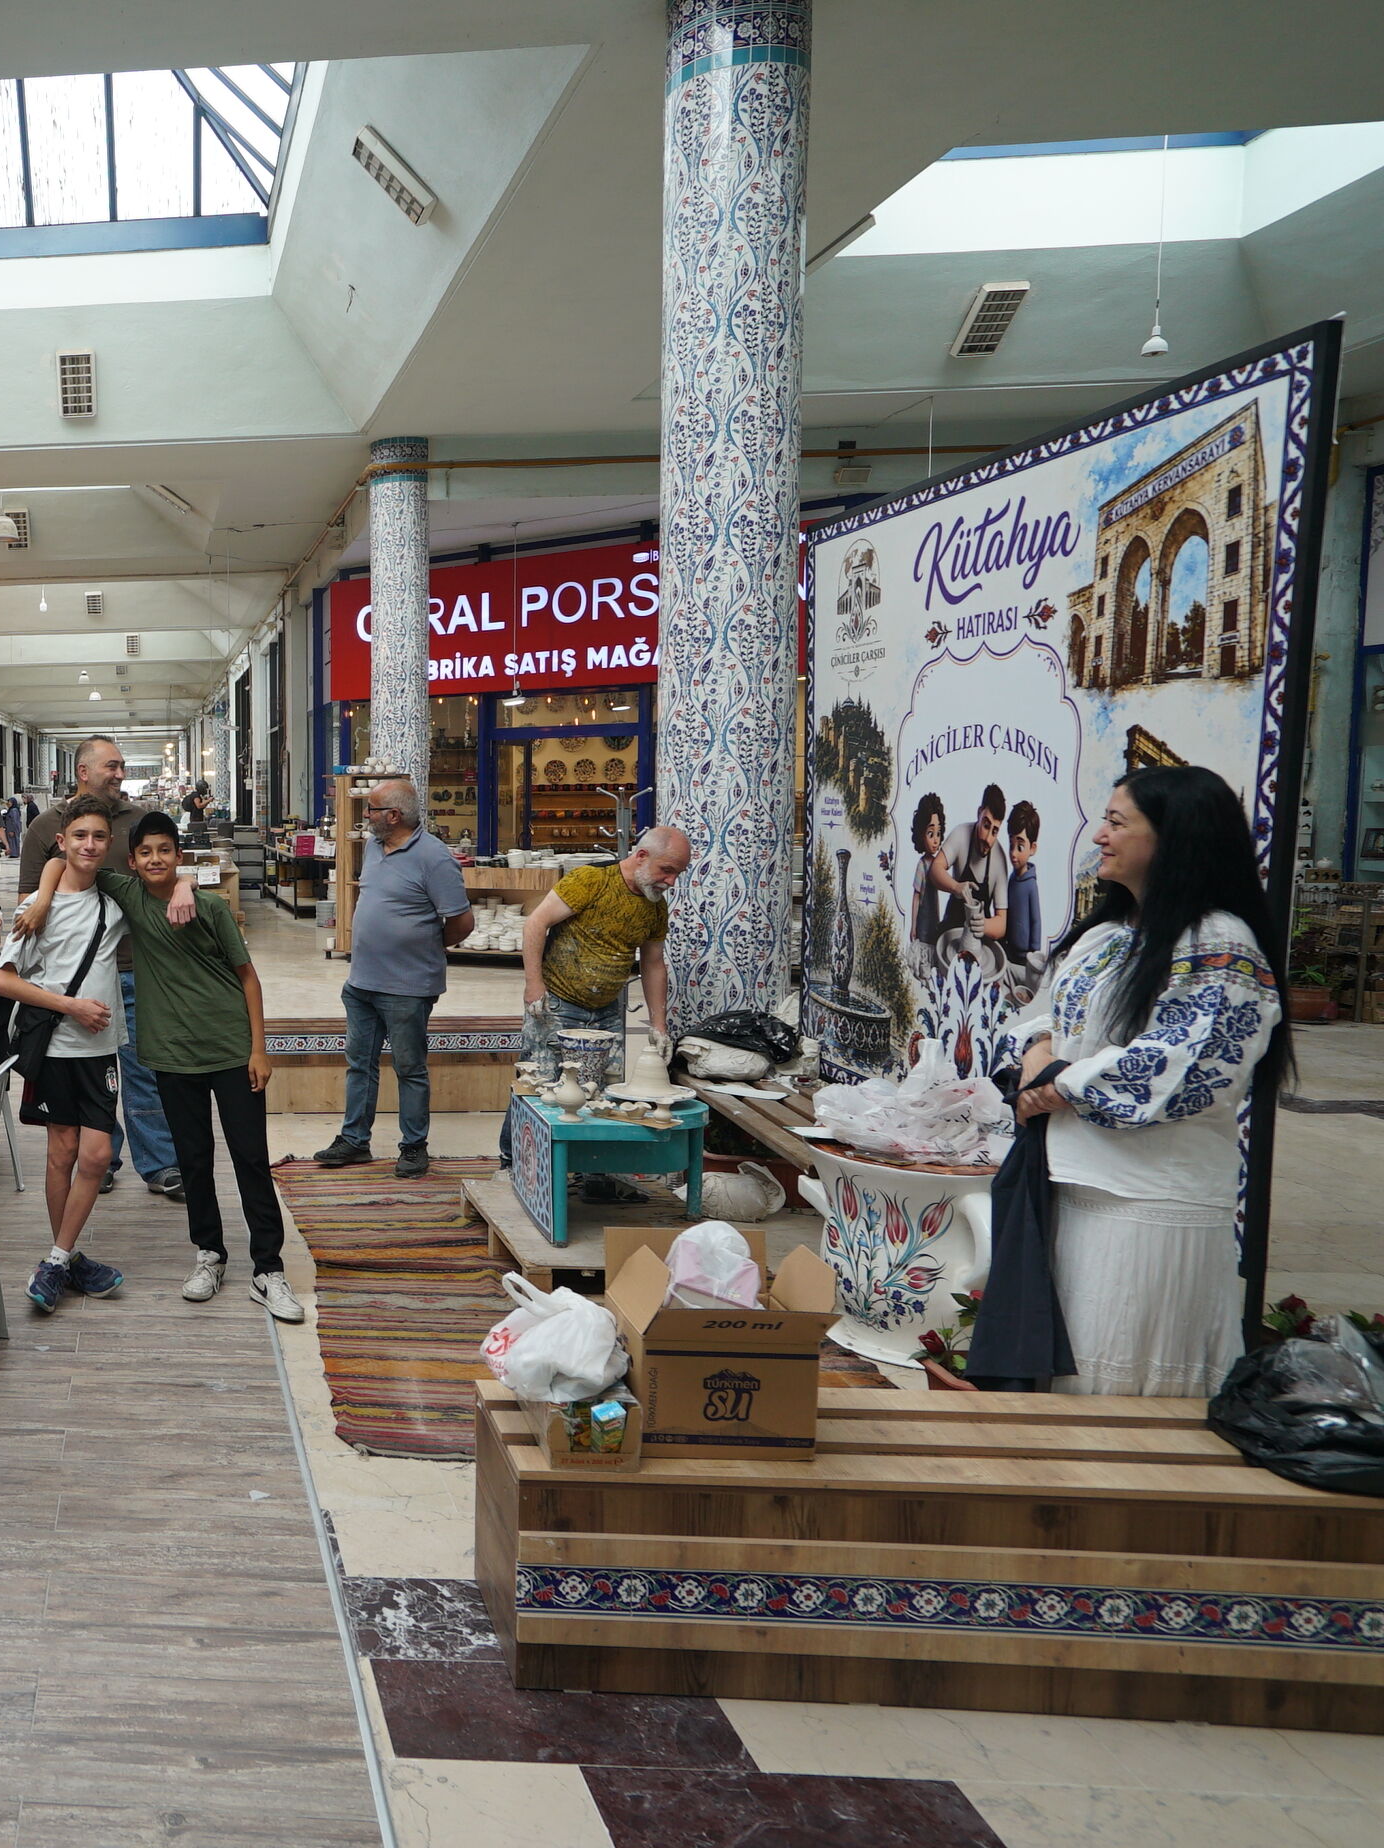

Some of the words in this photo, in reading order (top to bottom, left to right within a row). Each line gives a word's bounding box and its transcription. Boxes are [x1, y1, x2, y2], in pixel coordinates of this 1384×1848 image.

[913, 495, 1081, 611] Kütahya
[956, 606, 1018, 641] HATIRASI
[504, 647, 577, 678] SATIŞ
[905, 723, 985, 791] ÇİNİCİLER
[989, 723, 1060, 784] ÇARŞISI
[702, 1320, 748, 1330] 200
[751, 1321, 784, 1331] ml
